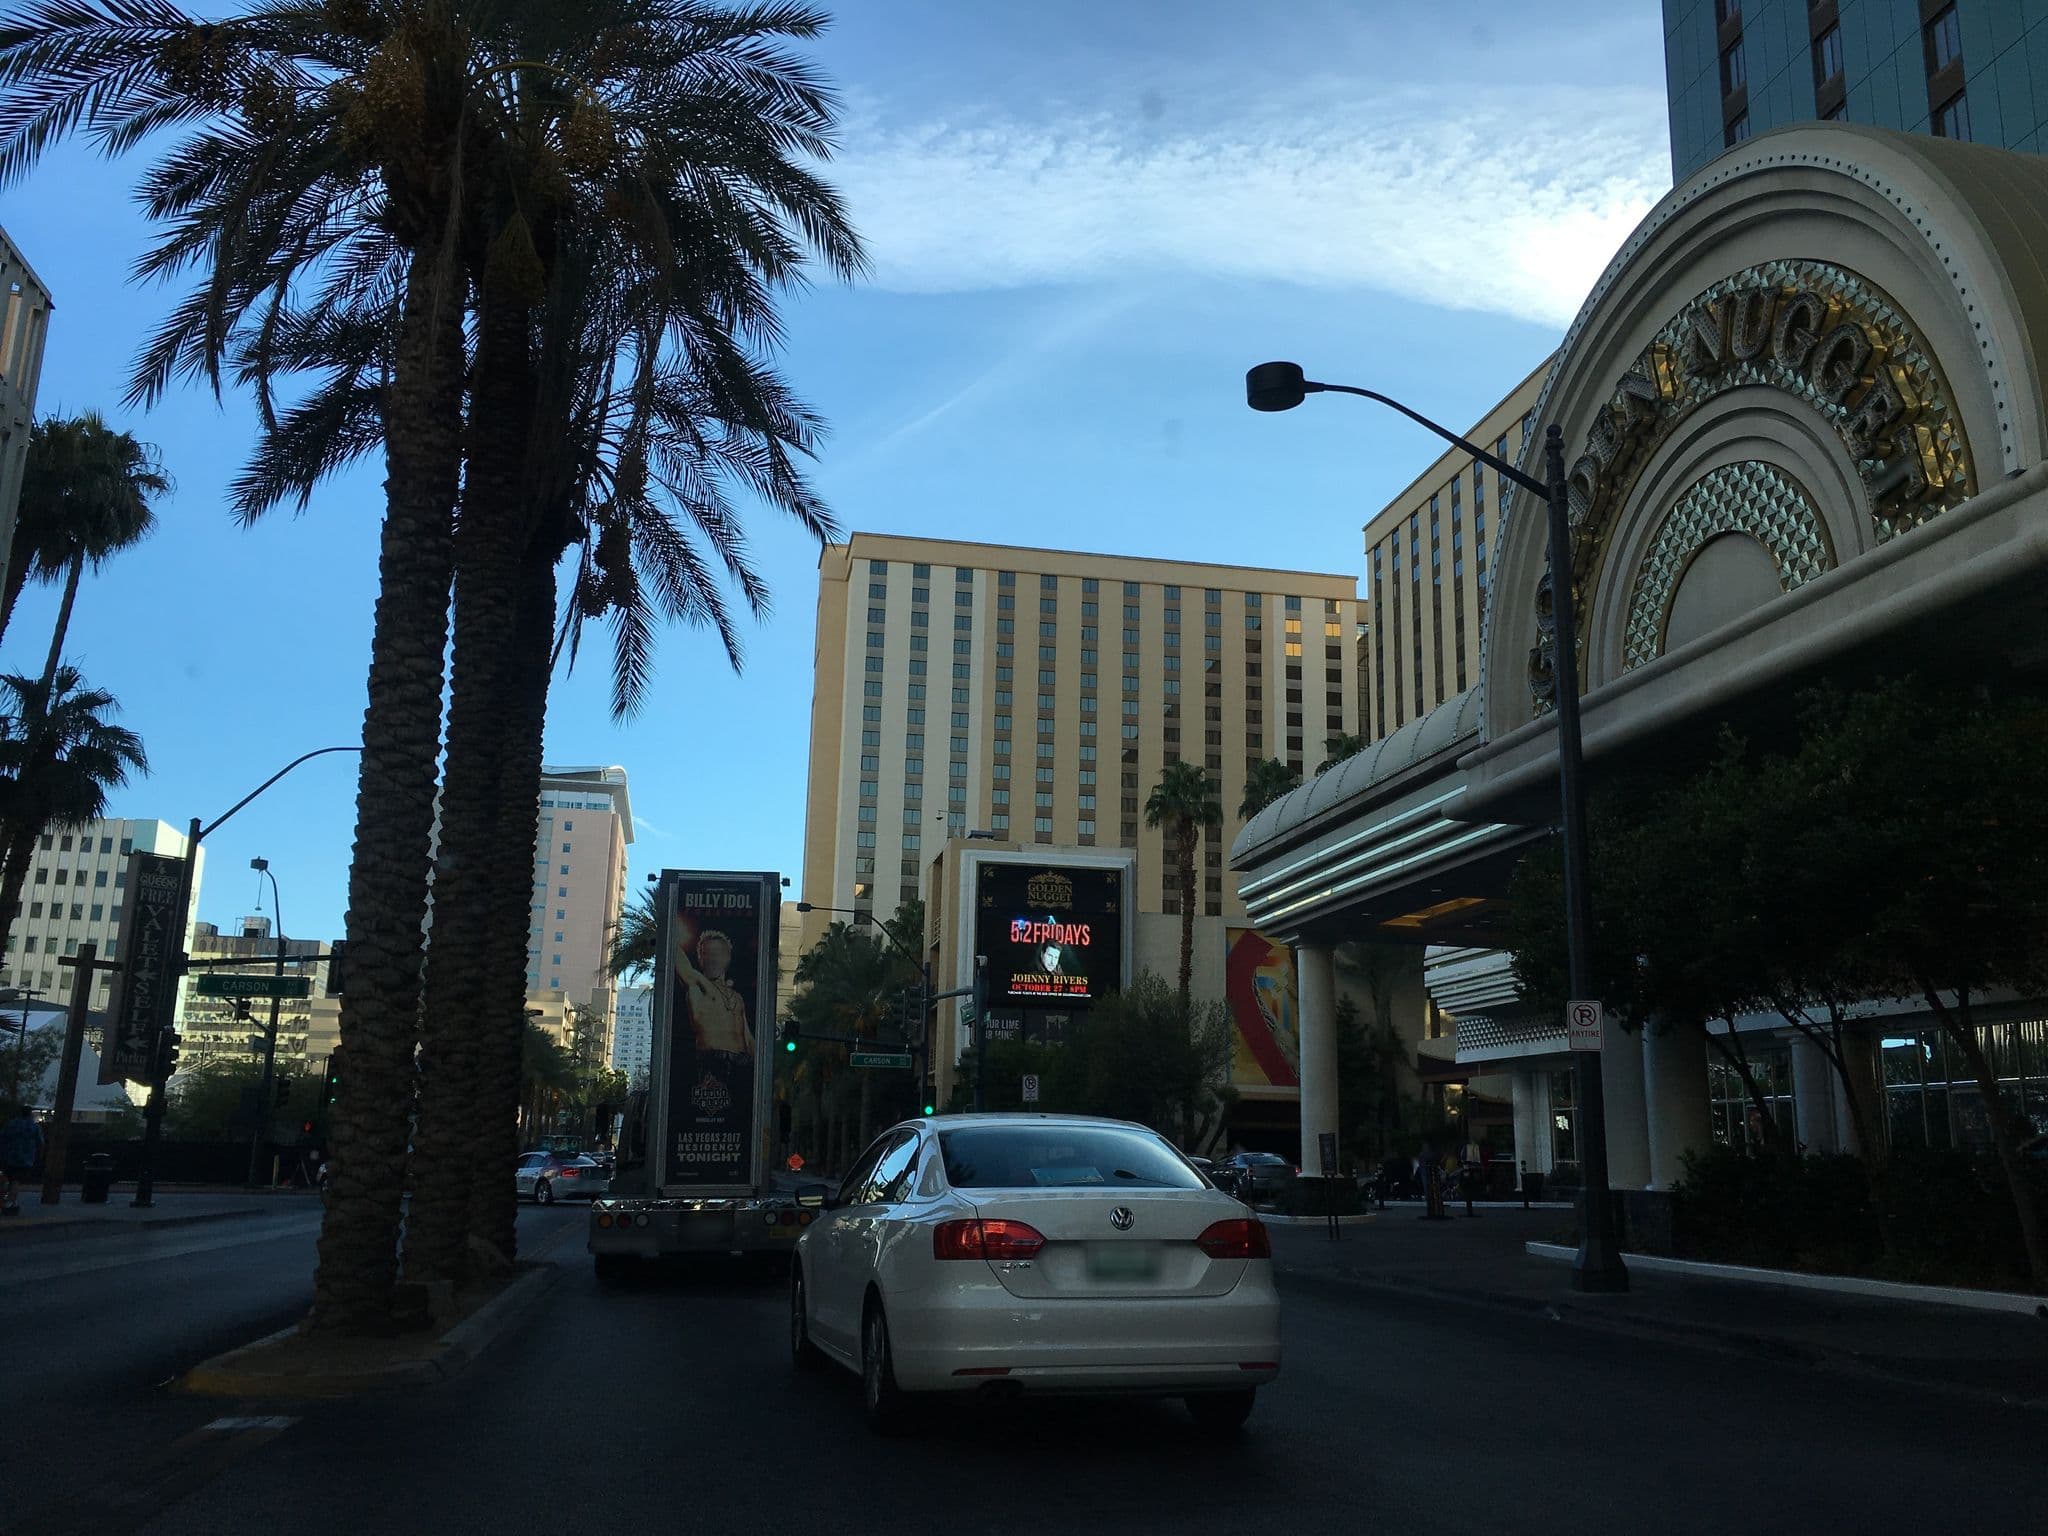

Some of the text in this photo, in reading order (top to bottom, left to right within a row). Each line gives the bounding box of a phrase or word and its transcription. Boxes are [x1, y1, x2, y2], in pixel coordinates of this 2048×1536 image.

[1686, 284, 1937, 516] NUGGET
[1028, 883, 1072, 894] GOLDEN
[139, 887, 177, 905] FREE
[685, 893, 753, 909] BILLY IDOL
[1028, 892, 1072, 902] NUGGET
[138, 904, 166, 969] VALET
[1011, 973, 1089, 985] JOHNNY RIVERS
[222, 981, 270, 992] CARSON
[1011, 983, 1051, 992] OCTOBER
[128, 982, 153, 1036] SELF
[1571, 1030, 1600, 1038] ANYTIME
[863, 1056, 891, 1065] CARSON
[679, 1132, 741, 1143] LAS VEGAS 2017
[678, 1144, 741, 1152] RESIDENCY
[677, 1153, 741, 1162] TONIGHT
